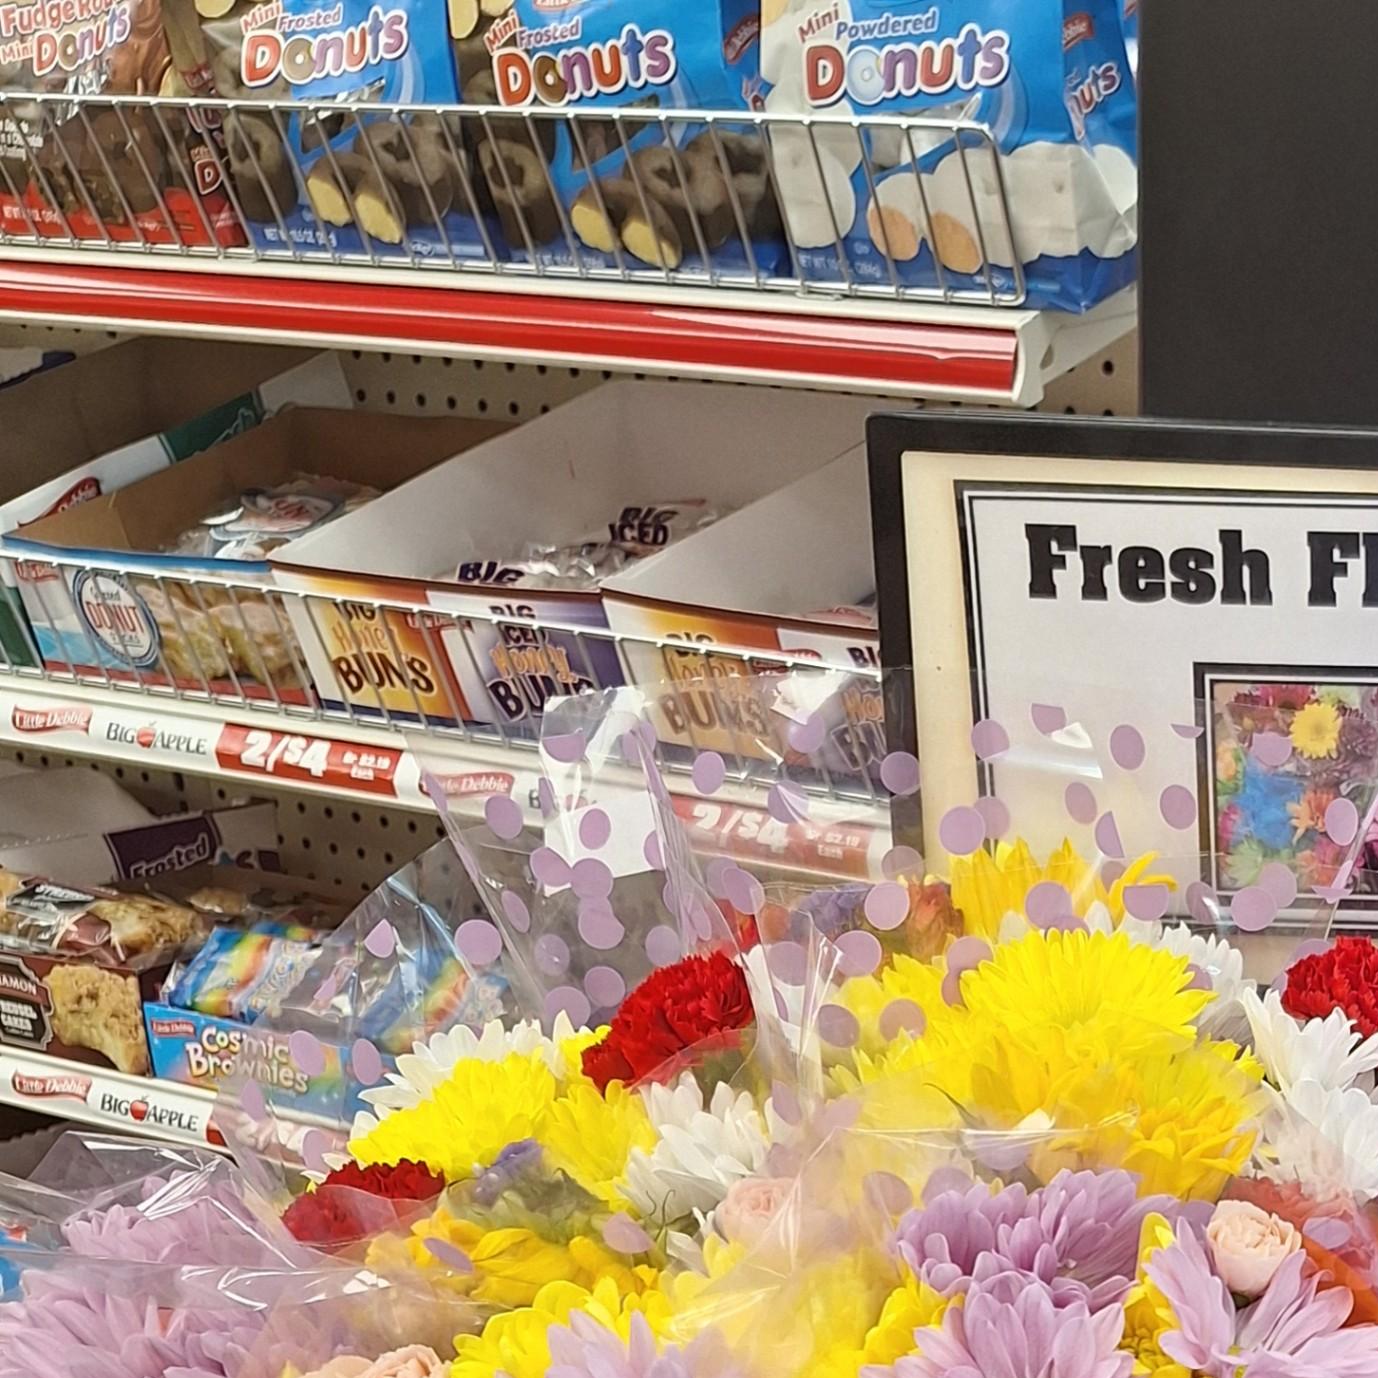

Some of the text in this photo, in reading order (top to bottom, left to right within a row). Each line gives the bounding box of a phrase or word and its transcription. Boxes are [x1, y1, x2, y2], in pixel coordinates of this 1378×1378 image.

[240, 2, 344, 34] Mini Frosted
[483, 9, 581, 54] Mini Frosted
[798, 2, 840, 44] Mini
[835, 6, 940, 41] Powdered
[33, 4, 131, 76] Donuts
[241, 5, 409, 87] Donuts
[492, 22, 677, 107] Donuts
[804, 22, 1010, 107] Donuts
[608, 522, 670, 545] ICED
[457, 561, 524, 585] BIG
[1025, 523, 1273, 606] Fresh
[332, 651, 435, 694] BUNS
[47, 711, 89, 727] Debbie
[107, 722, 207, 755] BIG APPLE
[461, 776, 509, 792] Debbie
[130, 833, 209, 879] Frosted
[201, 1026, 289, 1063] Cosmic
[45, 1079, 88, 1096] Debbie
[185, 1042, 310, 1094] Brownies
[100, 1093, 200, 1132] BIG APPLE
